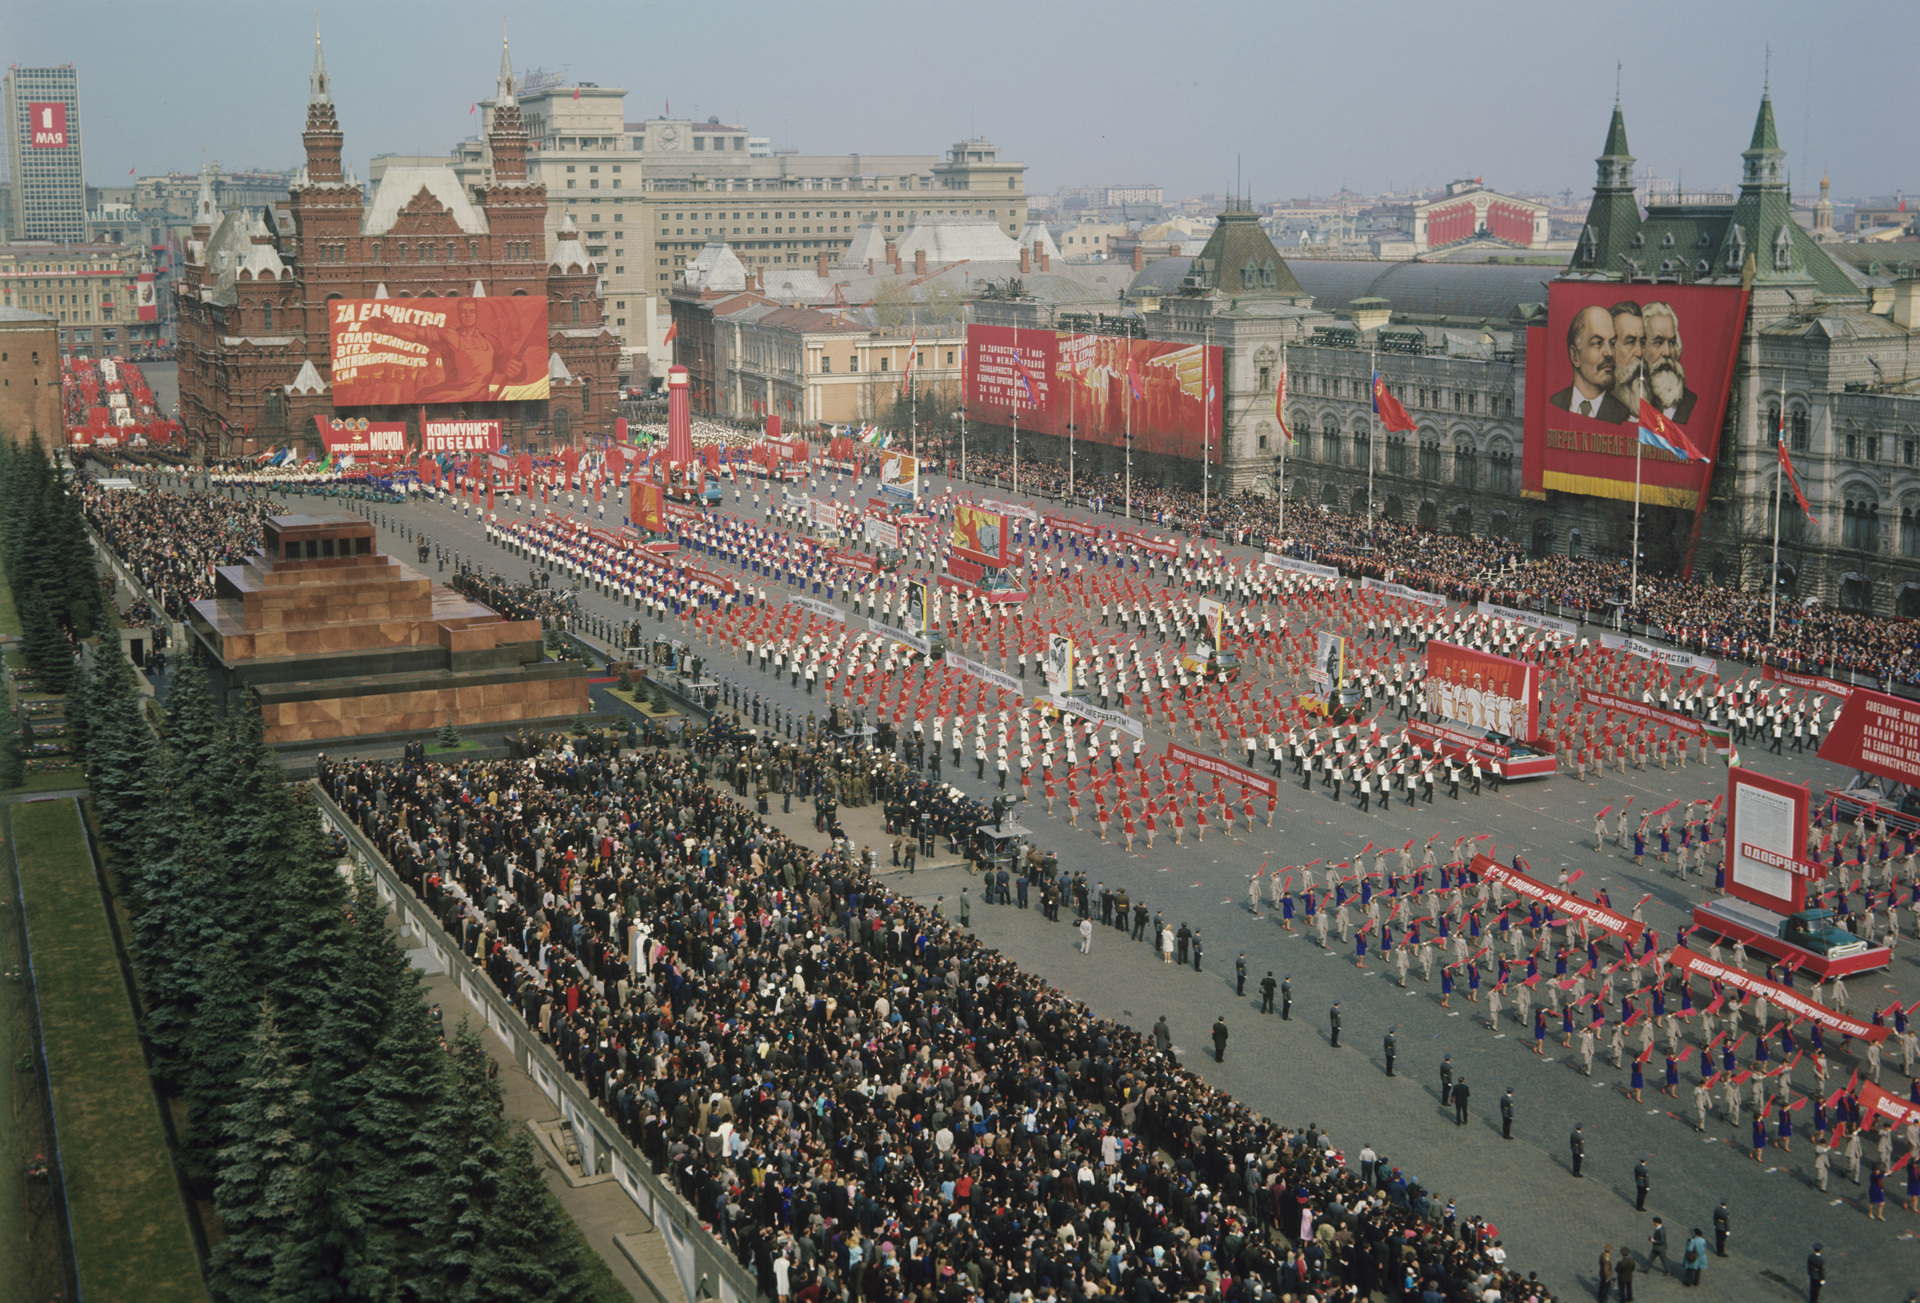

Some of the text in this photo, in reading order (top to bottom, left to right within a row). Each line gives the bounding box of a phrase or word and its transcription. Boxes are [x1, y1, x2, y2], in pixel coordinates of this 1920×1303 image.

[42, 108, 52, 128] 1
[36, 132, 62, 144] МАЯ
[84, 210, 138, 221] ЛАВА КПСС
[336, 304, 355, 323] ЗА
[348, 322, 362, 332] И
[336, 344, 370, 358] ВСЕХ
[337, 332, 430, 354] СПЛОЧЕННОСТЬ
[980, 354, 1045, 369] ДЕНЬ МЕЖДУАРОДНОЙ
[336, 368, 357, 382] СИЛ
[981, 374, 995, 383] БОРЬБЕ
[997, 376, 1013, 386] ПРОТИВ
[1007, 388, 1045, 400] ДЕМОКРЮ
[427, 422, 498, 437] КОММУНИЗ
[331, 432, 404, 451] ГОРОД-ГЕРОЙ МОСКВА
[1582, 432, 1588, 451] К
[1590, 433, 1624, 456] ПОБЕДЕ
[1625, 640, 1648, 653] ПОЗОР
[1452, 660, 1512, 682] ЕДИНСТВО!
[1817, 680, 1854, 696] МАРКСИЗМ-
[1866, 700, 1901, 719] СОВЕЩАНИЕ
[1877, 716, 1918, 737] И РАБОЧИХ
[1864, 724, 1918, 749] ВАЖНЫЙ ЭТАП
[1863, 737, 1871, 748] ЗА
[1873, 740, 1904, 758] ЕДИНСТВО
[1689, 958, 1723, 979] БРАТСКИЙ
[1722, 971, 1749, 987] ПРИВЕТ
[1774, 990, 1840, 1027] СОЦИАЛИСТИЧЕСКИХ
[1838, 1021, 1869, 1036] СТРАН!
[1877, 1096, 1908, 1119] ВЫШЕ
